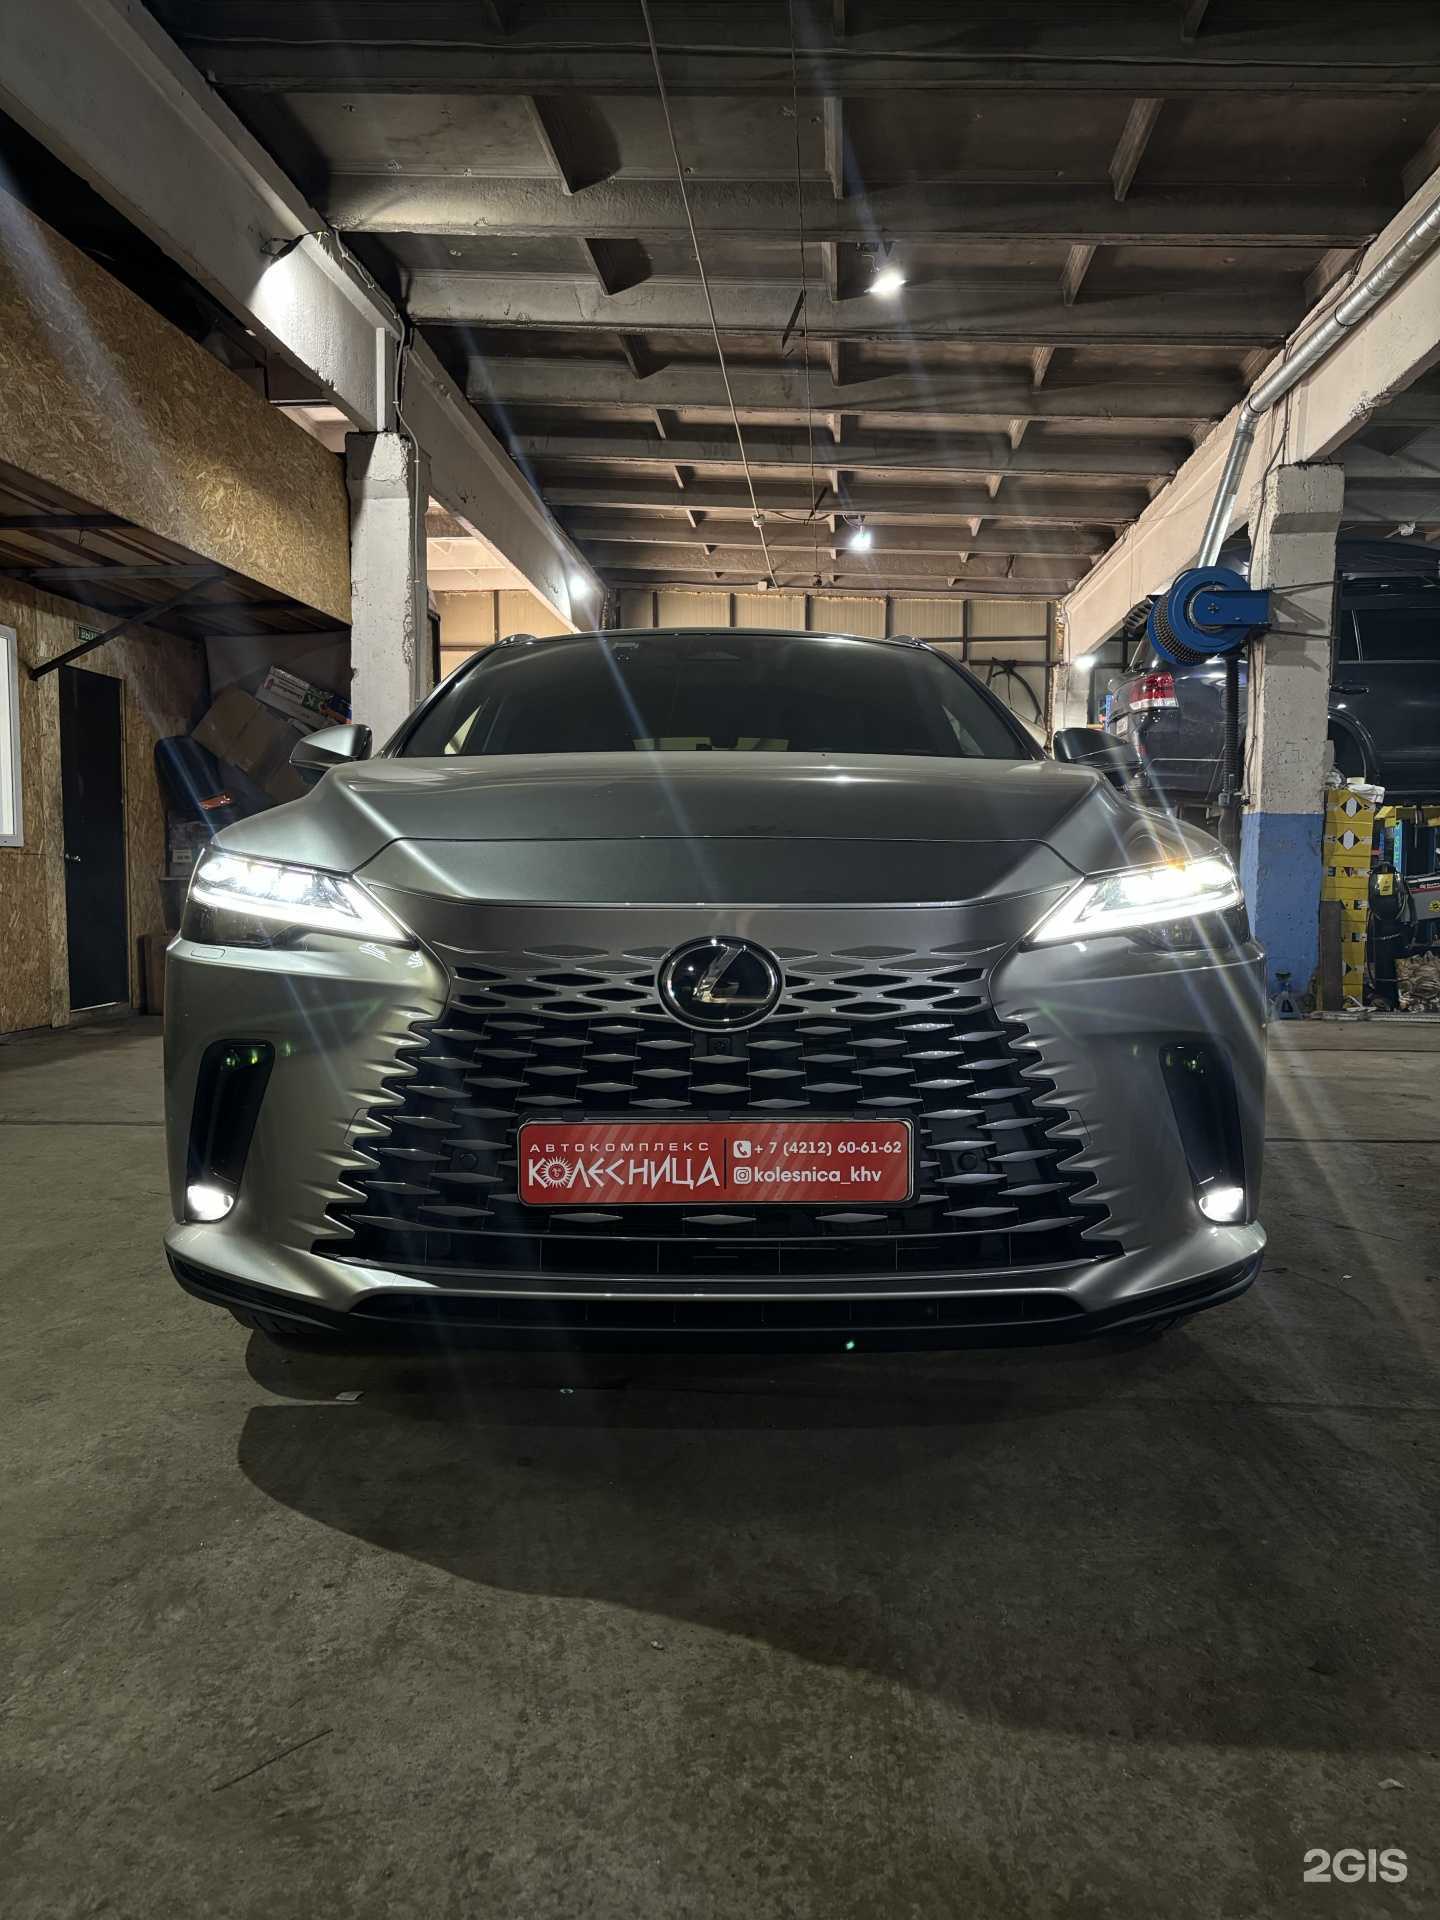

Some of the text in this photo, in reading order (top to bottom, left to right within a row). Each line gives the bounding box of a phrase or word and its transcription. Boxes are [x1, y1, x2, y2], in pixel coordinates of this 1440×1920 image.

[529, 1142, 710, 1153] АВТОКОМПЛЕКС
[783, 1141, 832, 1156] (4212)
[838, 1141, 902, 1154] 60-61-62
[528, 1153, 720, 1190] КОЛЕСНИЦА
[754, 1166, 882, 1185] kolesnica_khv
